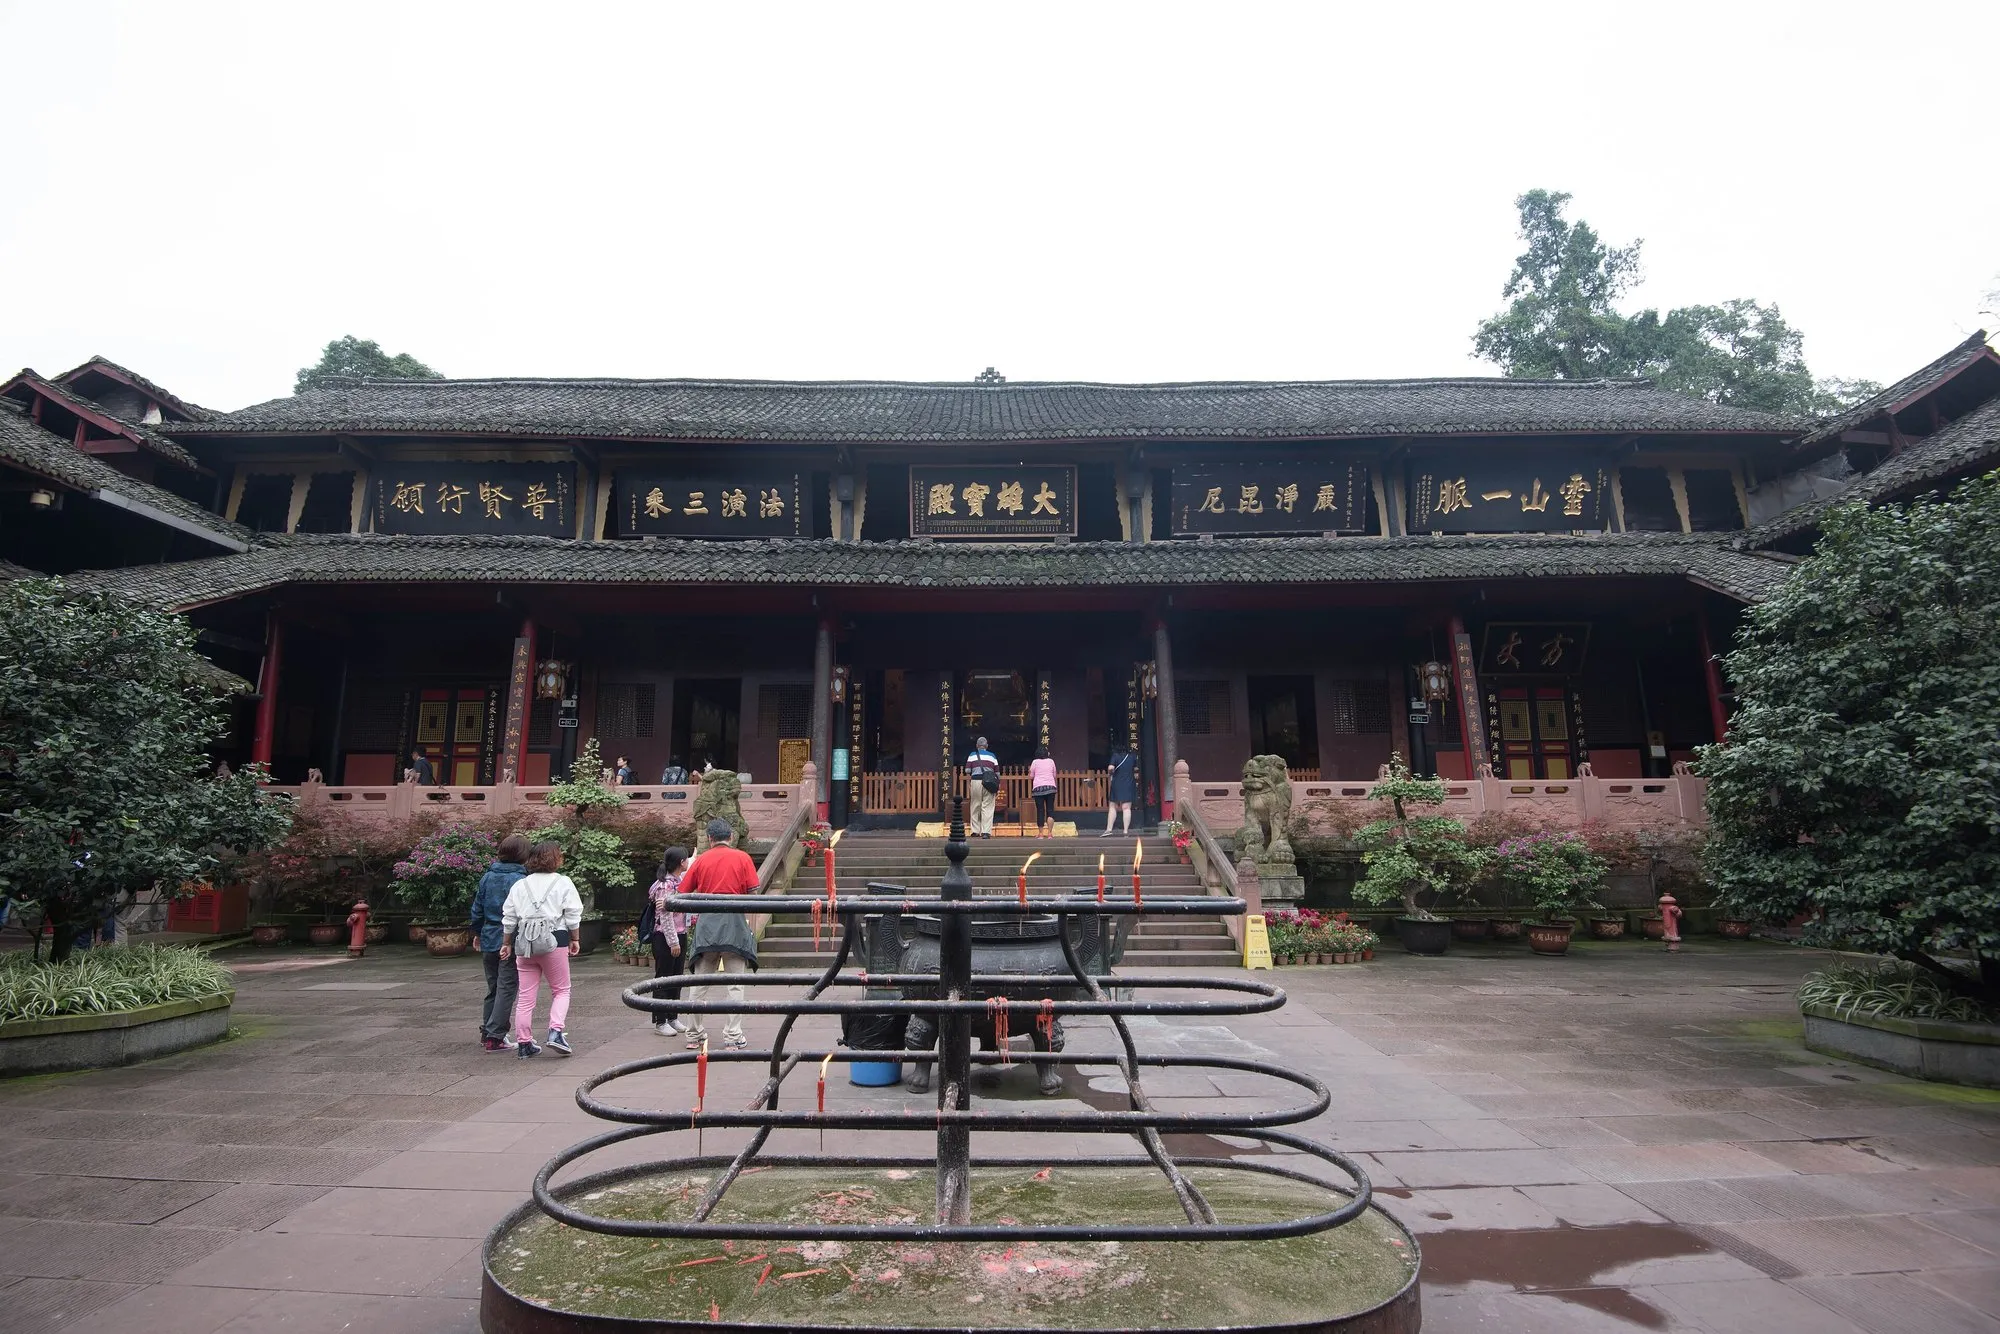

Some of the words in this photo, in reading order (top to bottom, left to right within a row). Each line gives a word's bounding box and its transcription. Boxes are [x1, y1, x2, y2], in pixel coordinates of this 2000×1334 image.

[927, 481, 1060, 517] 大雄寶殿
[1433, 473, 1592, 516] 靈山一脈
